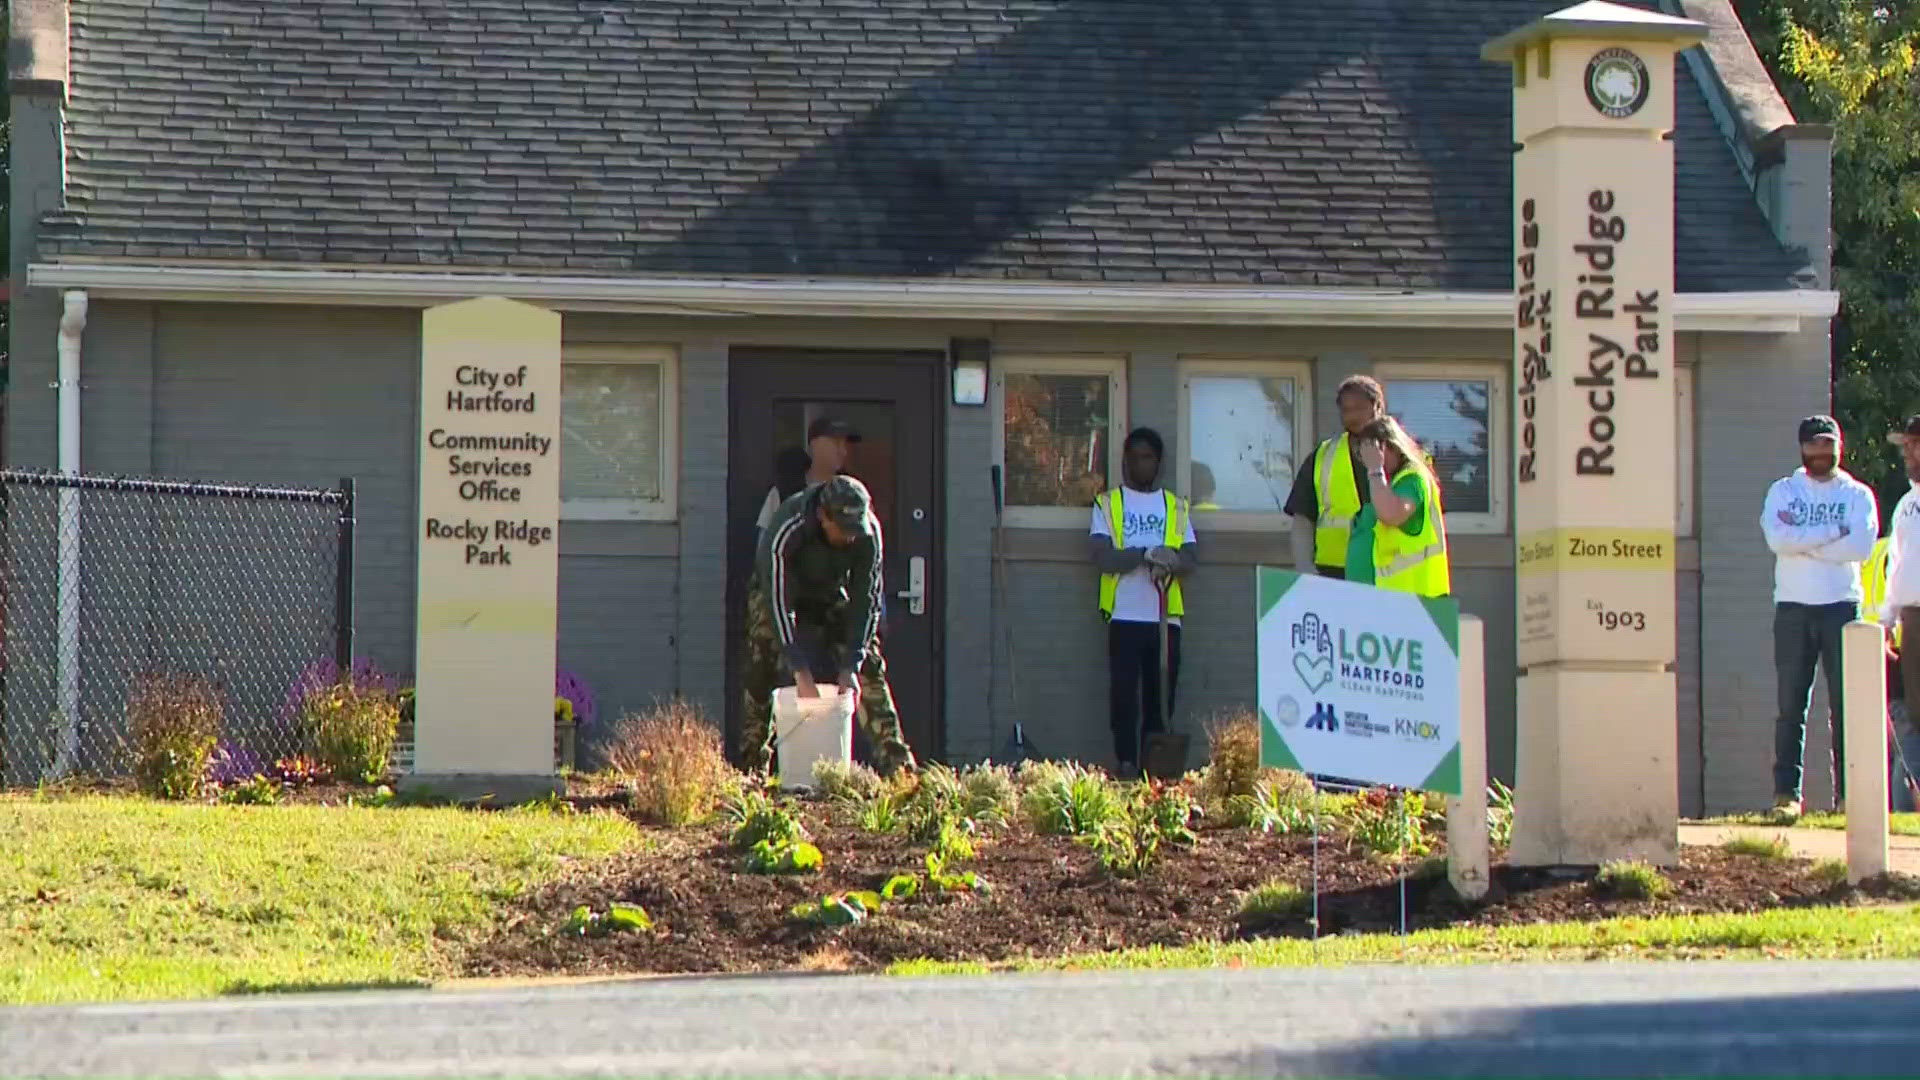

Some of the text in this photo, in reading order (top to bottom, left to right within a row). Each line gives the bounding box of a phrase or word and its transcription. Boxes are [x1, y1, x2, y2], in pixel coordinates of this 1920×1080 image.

[1573, 189, 1625, 476] Rocky Ridge
[1622, 289, 1659, 379] Park
[455, 365, 527, 391] City of
[447, 391, 535, 413] Hartford
[1519, 343, 1539, 482] Rocky
[428, 428, 551, 456] Community
[448, 455, 532, 477] Services
[459, 480, 521, 502] Office
[426, 518, 552, 546] Rocky Ridge
[465, 545, 511, 565] Park
[1569, 538, 1663, 559] Zion Street
[1597, 611, 1646, 632] 1903
[1339, 627, 1424, 673] LOVE
[1341, 663, 1424, 689] HARTFORD
[1395, 717, 1441, 741] KNOX
